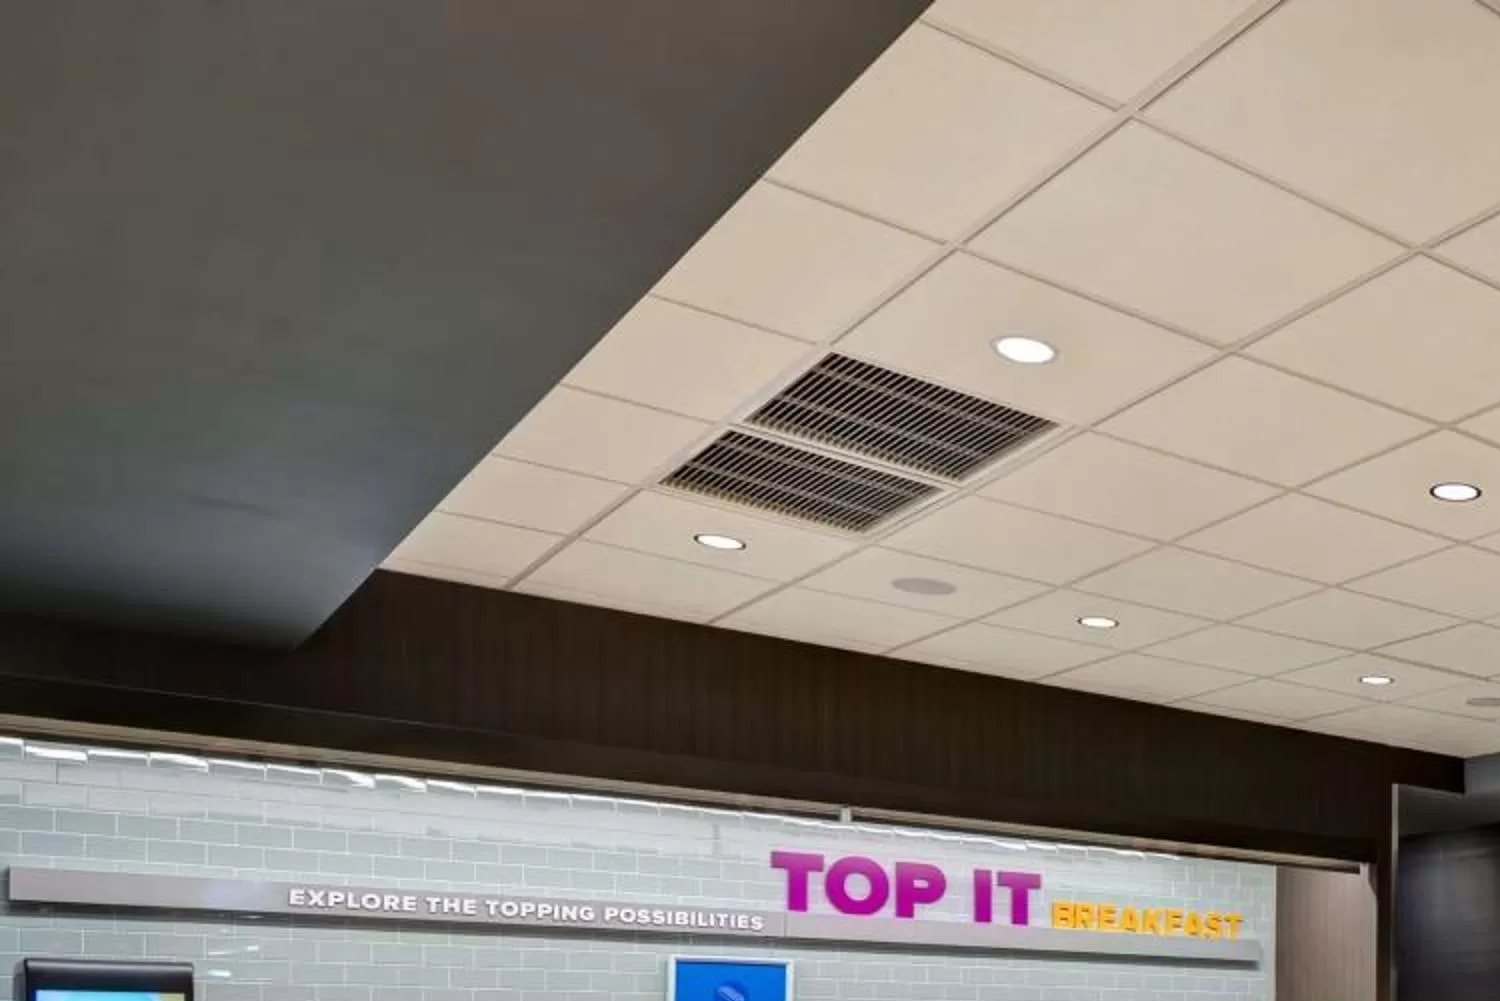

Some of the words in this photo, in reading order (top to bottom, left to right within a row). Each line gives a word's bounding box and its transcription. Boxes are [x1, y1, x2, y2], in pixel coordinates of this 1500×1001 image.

[288, 887, 417, 912] EXPLORE
[426, 896, 477, 915] THE
[485, 899, 595, 922] TOPPING
[604, 907, 764, 932] POSSIBILITIES
[770, 851, 947, 919] TOP
[973, 868, 1041, 925] IT
[1051, 901, 1245, 941] BREAKFAST
